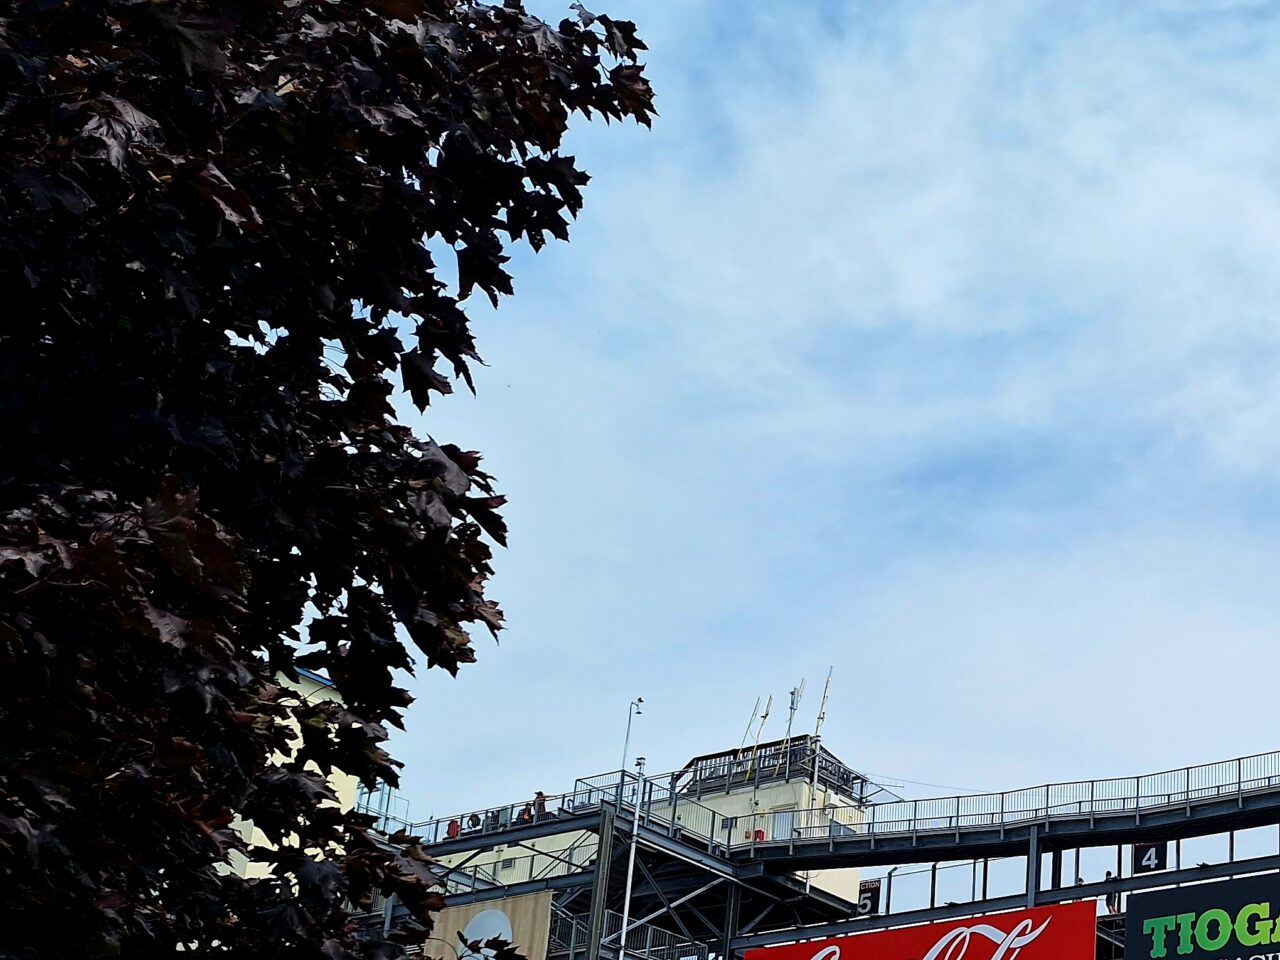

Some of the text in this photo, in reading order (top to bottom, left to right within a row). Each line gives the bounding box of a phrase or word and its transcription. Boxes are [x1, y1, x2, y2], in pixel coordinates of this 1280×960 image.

[1141, 847, 1158, 868] 4
[860, 881, 880, 890] CTION
[858, 892, 872, 914] 5
